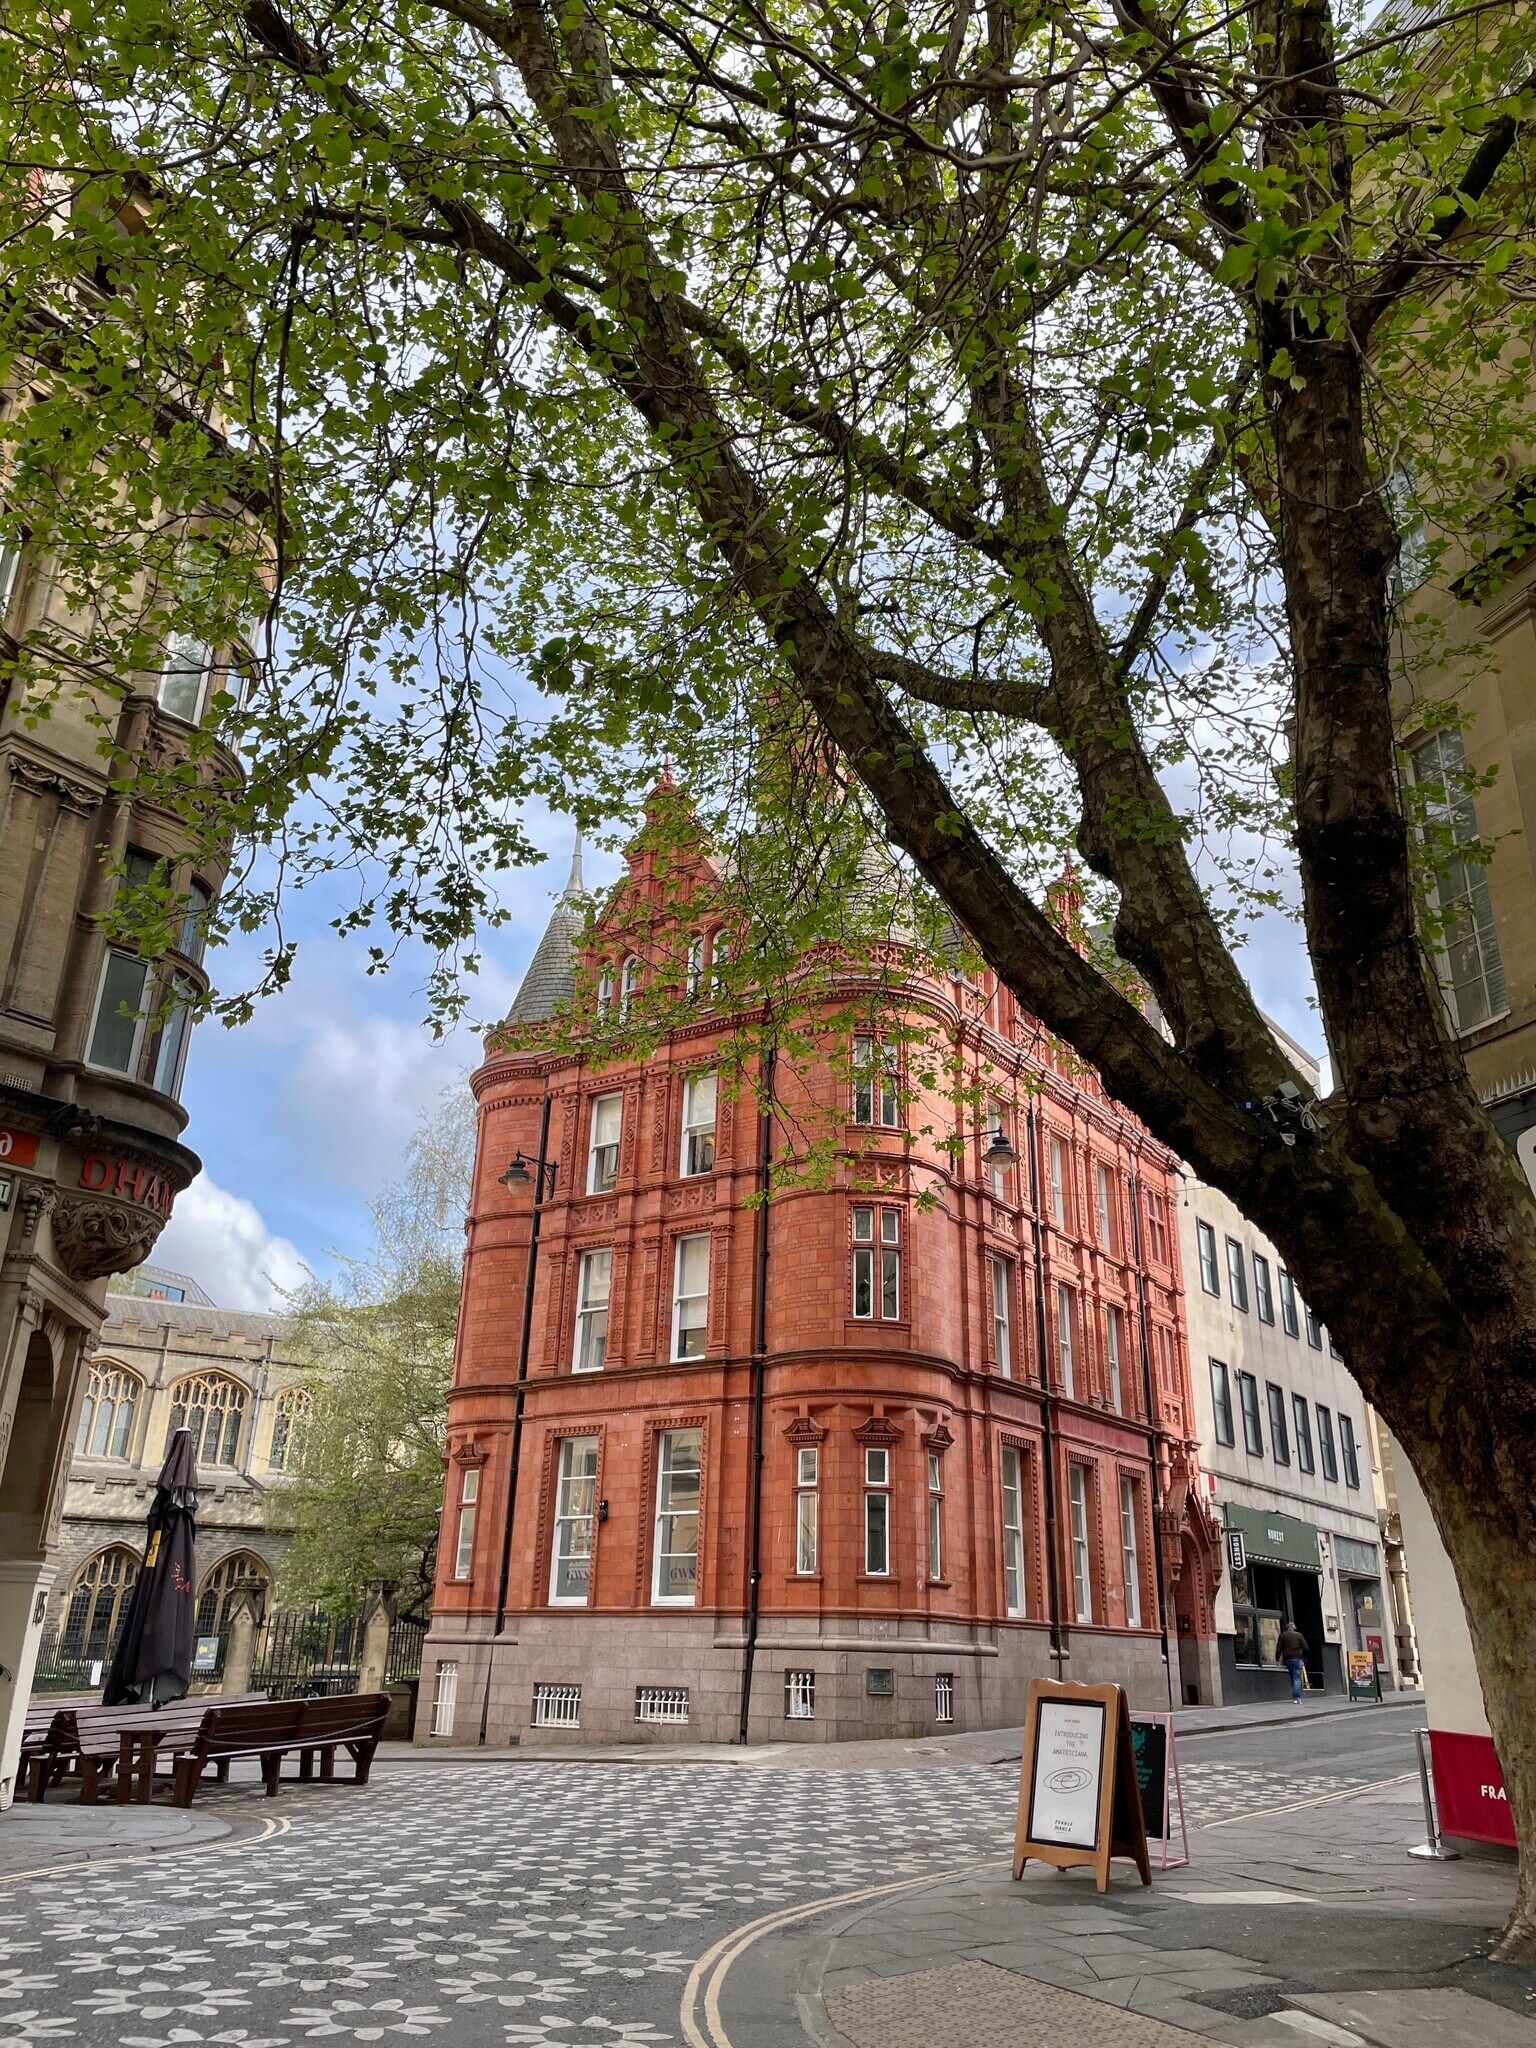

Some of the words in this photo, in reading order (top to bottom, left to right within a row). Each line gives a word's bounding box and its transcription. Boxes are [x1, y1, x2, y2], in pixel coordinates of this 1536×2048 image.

[1267, 1528, 1285, 1542] HONEST
[1232, 1536, 1242, 1566] HONEST
[1054, 1730, 1089, 1740] INTRODUCING
[1066, 1740, 1076, 1748] THE
[1052, 1748, 1088, 1758] AMATRICIANA
